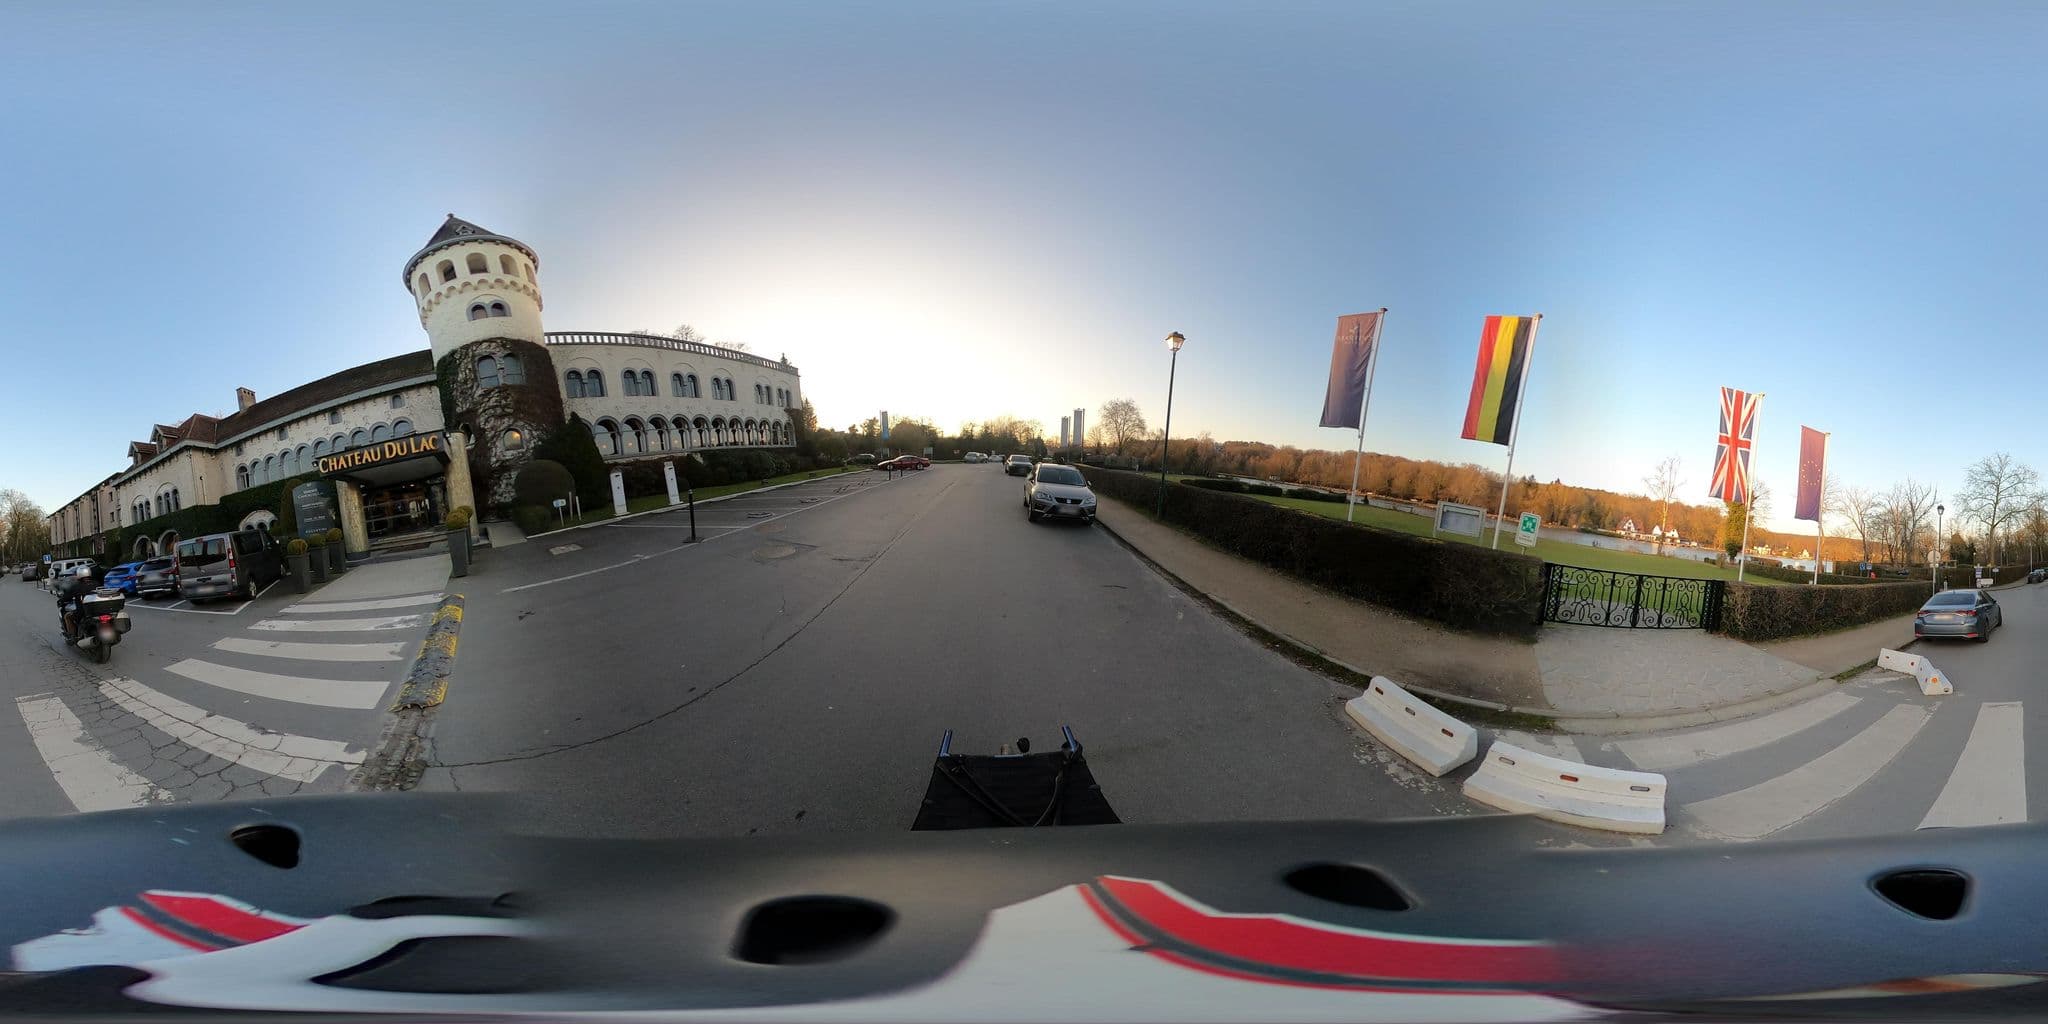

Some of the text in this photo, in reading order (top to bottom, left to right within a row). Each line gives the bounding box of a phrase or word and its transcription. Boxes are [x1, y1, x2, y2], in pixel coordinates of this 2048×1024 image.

[319, 435, 439, 474] CHATEAU DU LAC
